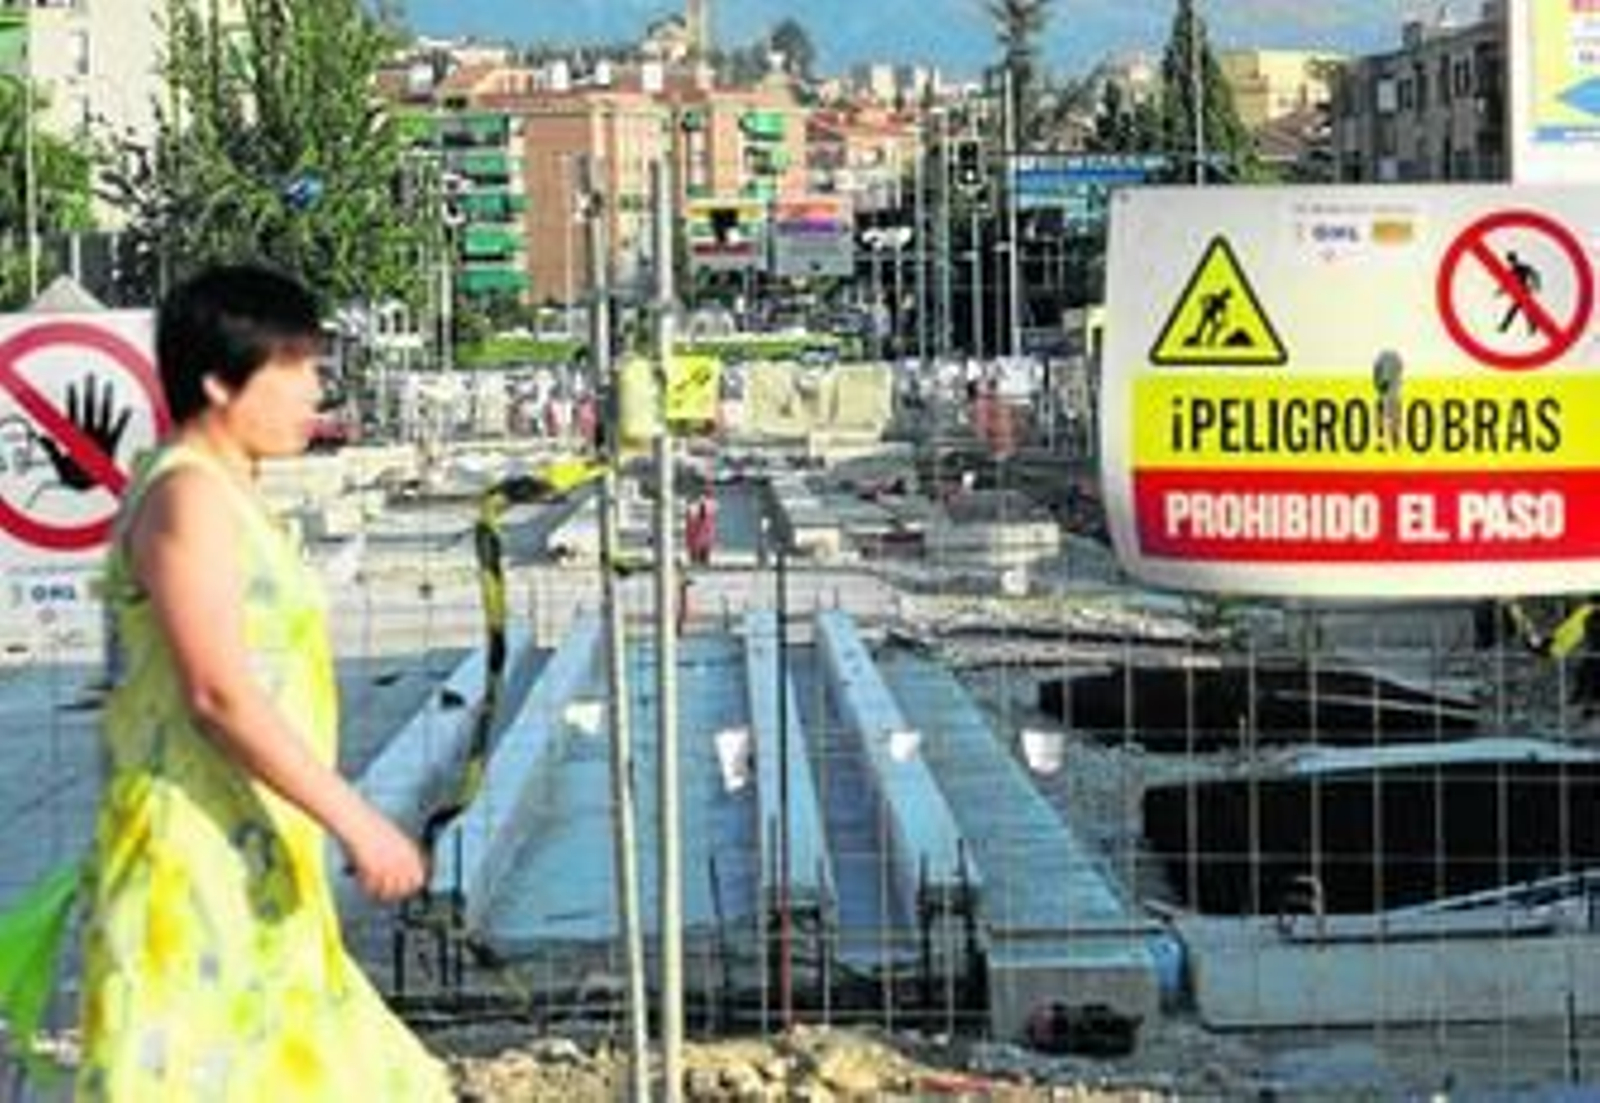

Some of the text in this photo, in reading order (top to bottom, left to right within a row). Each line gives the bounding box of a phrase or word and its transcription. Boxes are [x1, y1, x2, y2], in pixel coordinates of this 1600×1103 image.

[1406, 398, 1562, 453] OBRAS
[1164, 490, 1565, 541] PROHIBIDO EL PASO
